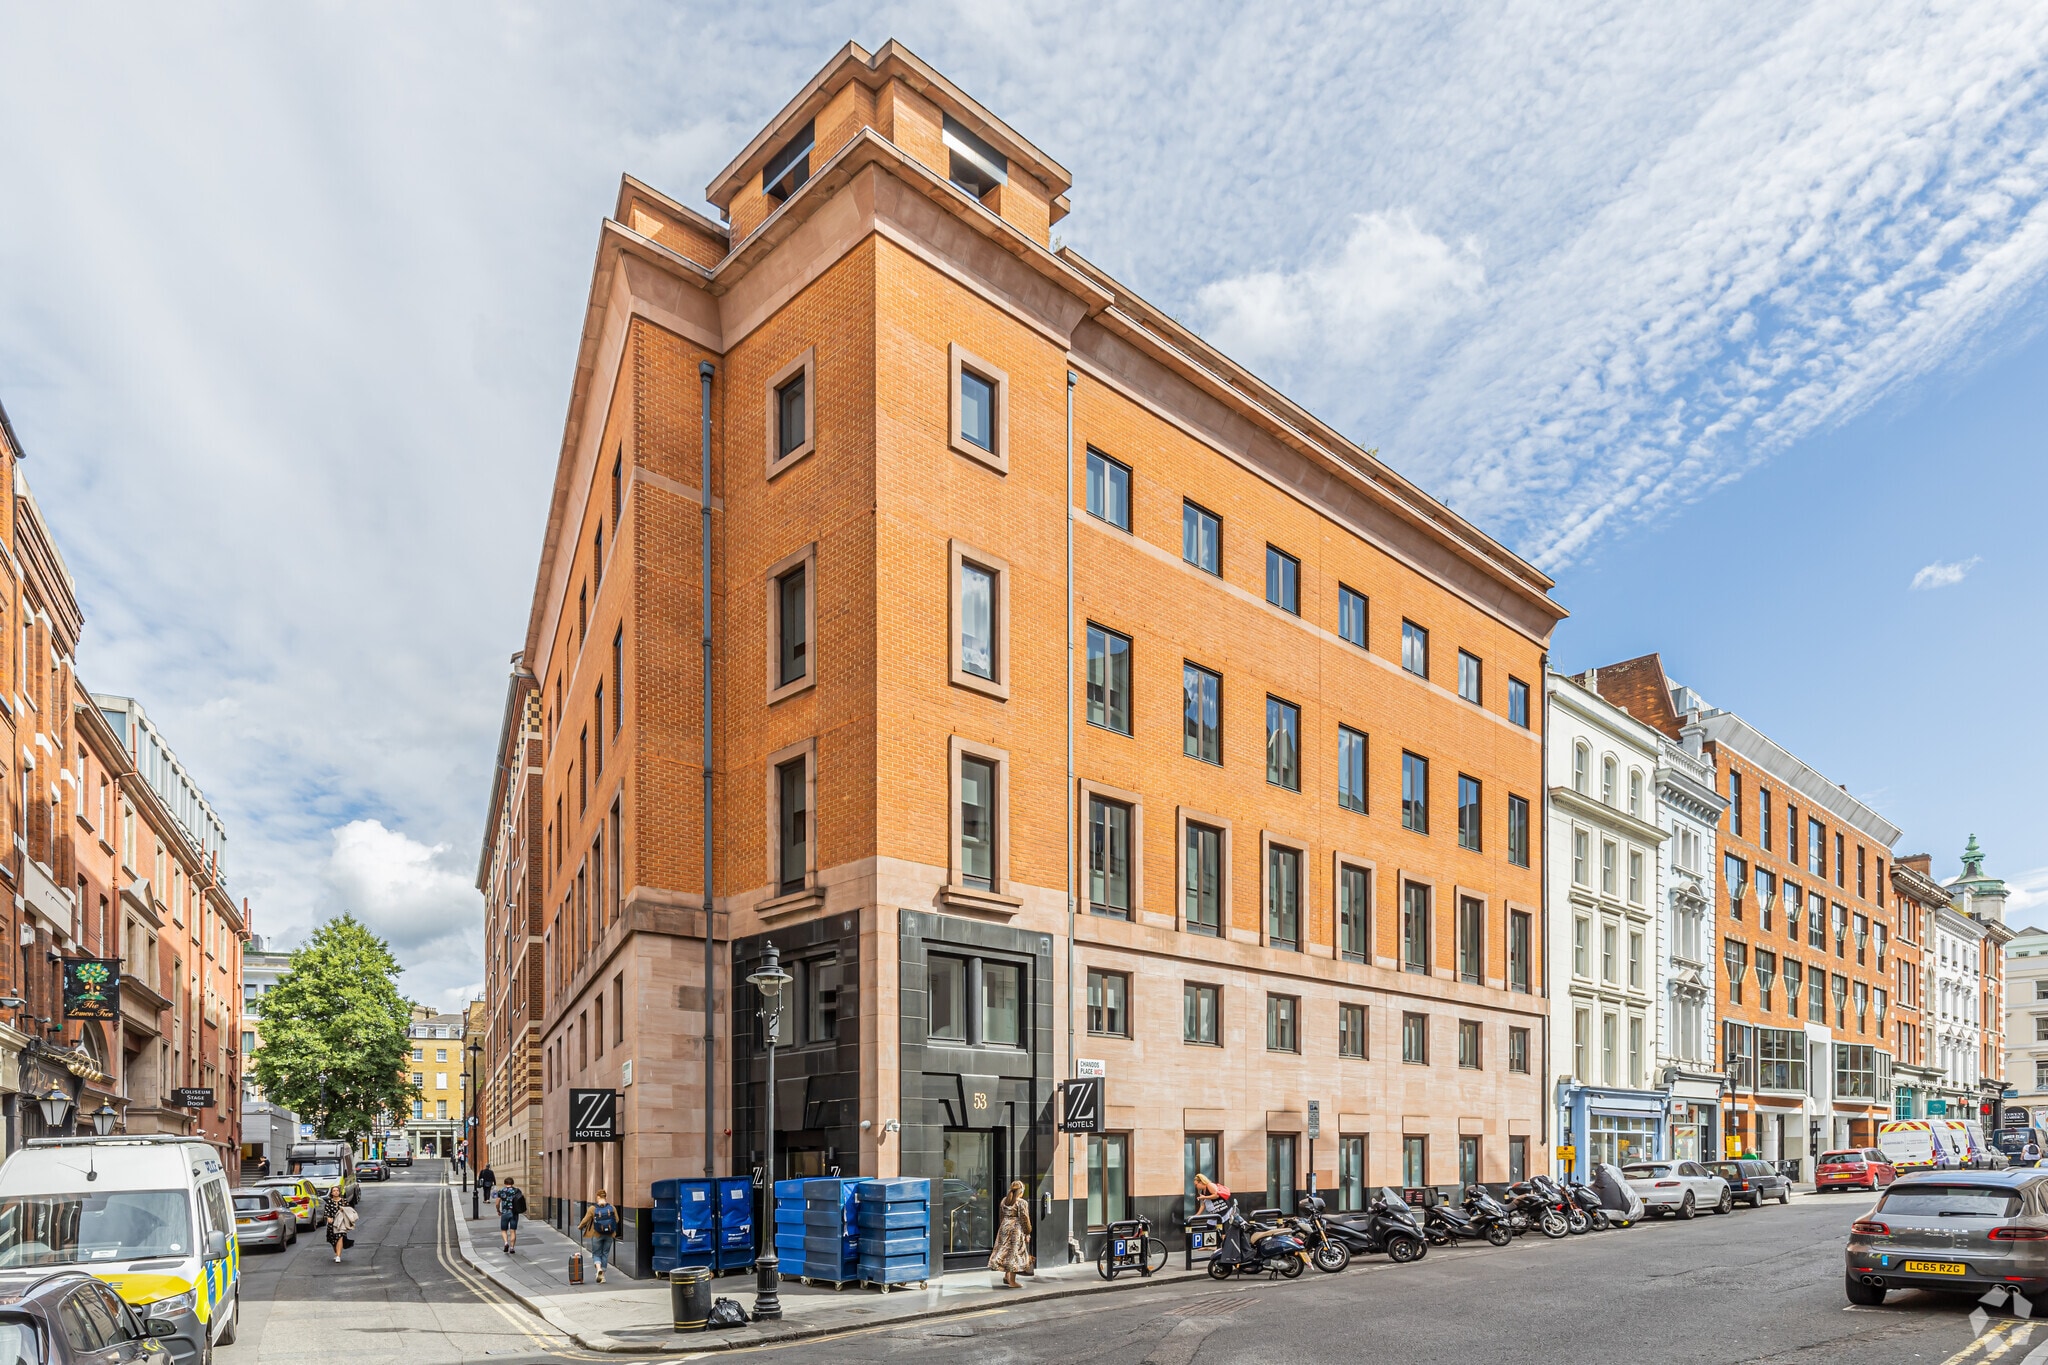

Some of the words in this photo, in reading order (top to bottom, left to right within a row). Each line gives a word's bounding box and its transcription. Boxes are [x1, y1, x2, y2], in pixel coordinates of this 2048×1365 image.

[82, 1000, 99, 1009] The
[67, 1008, 94, 1017] Lemon
[95, 1009, 114, 1017] Tree
[974, 1092, 987, 1109] 53
[1067, 1083, 1094, 1120] Z
[576, 1094, 611, 1128] Z
[1067, 1120, 1094, 1128] HOTELS
[753, 1167, 763, 1184] Z
[1195, 1235, 1201, 1247] P
[1117, 1242, 1123, 1254] P
[1910, 1262, 1936, 1271] LC65
[1940, 1264, 1960, 1273] RZG
